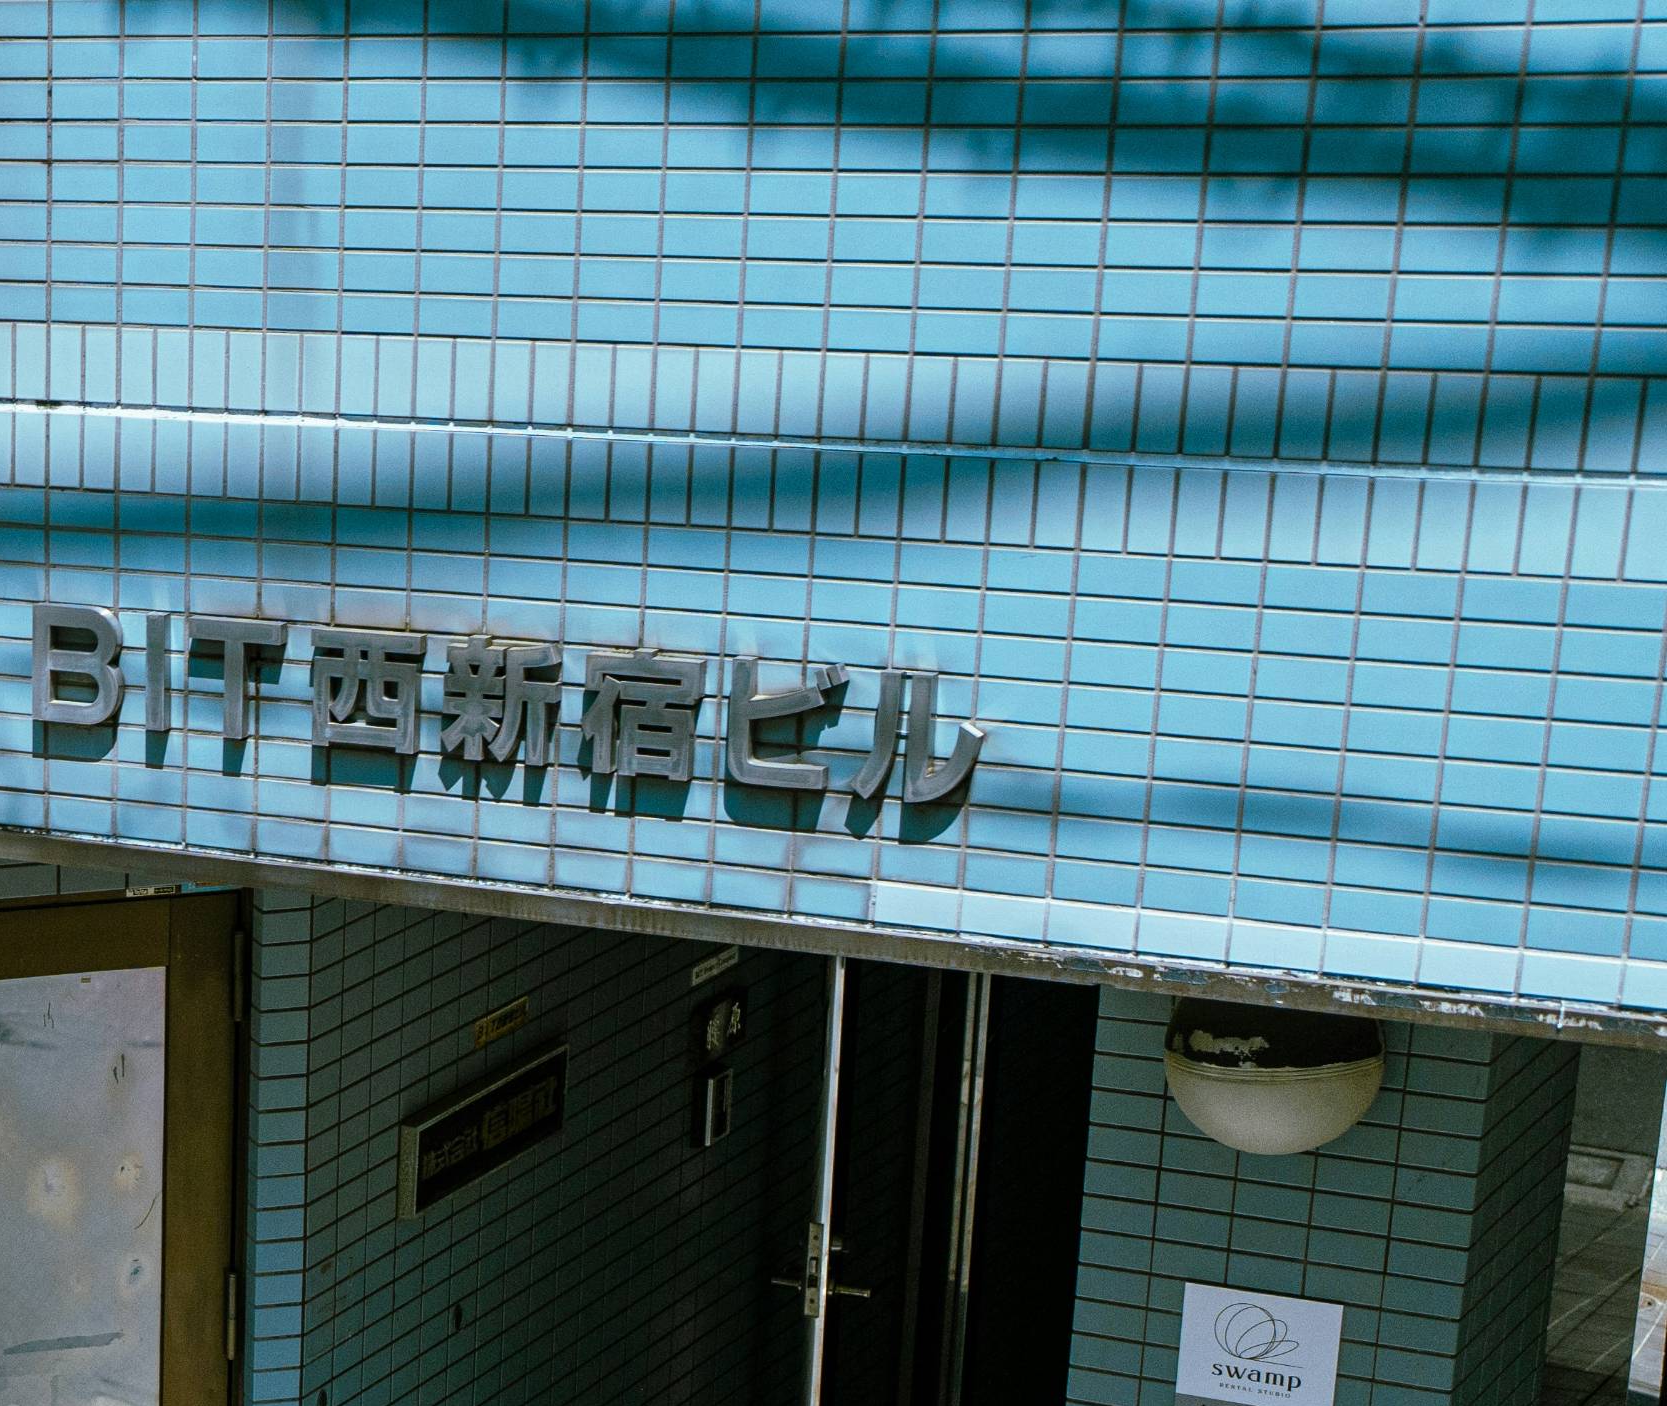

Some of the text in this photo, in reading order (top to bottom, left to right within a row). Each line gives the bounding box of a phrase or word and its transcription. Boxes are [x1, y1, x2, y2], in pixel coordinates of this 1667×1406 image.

[33, 602, 987, 804] BIT西新宿ビル
[1211, 1363, 1302, 1392] swamp
[1219, 1382, 1292, 1399] RENTAL STUDIO
